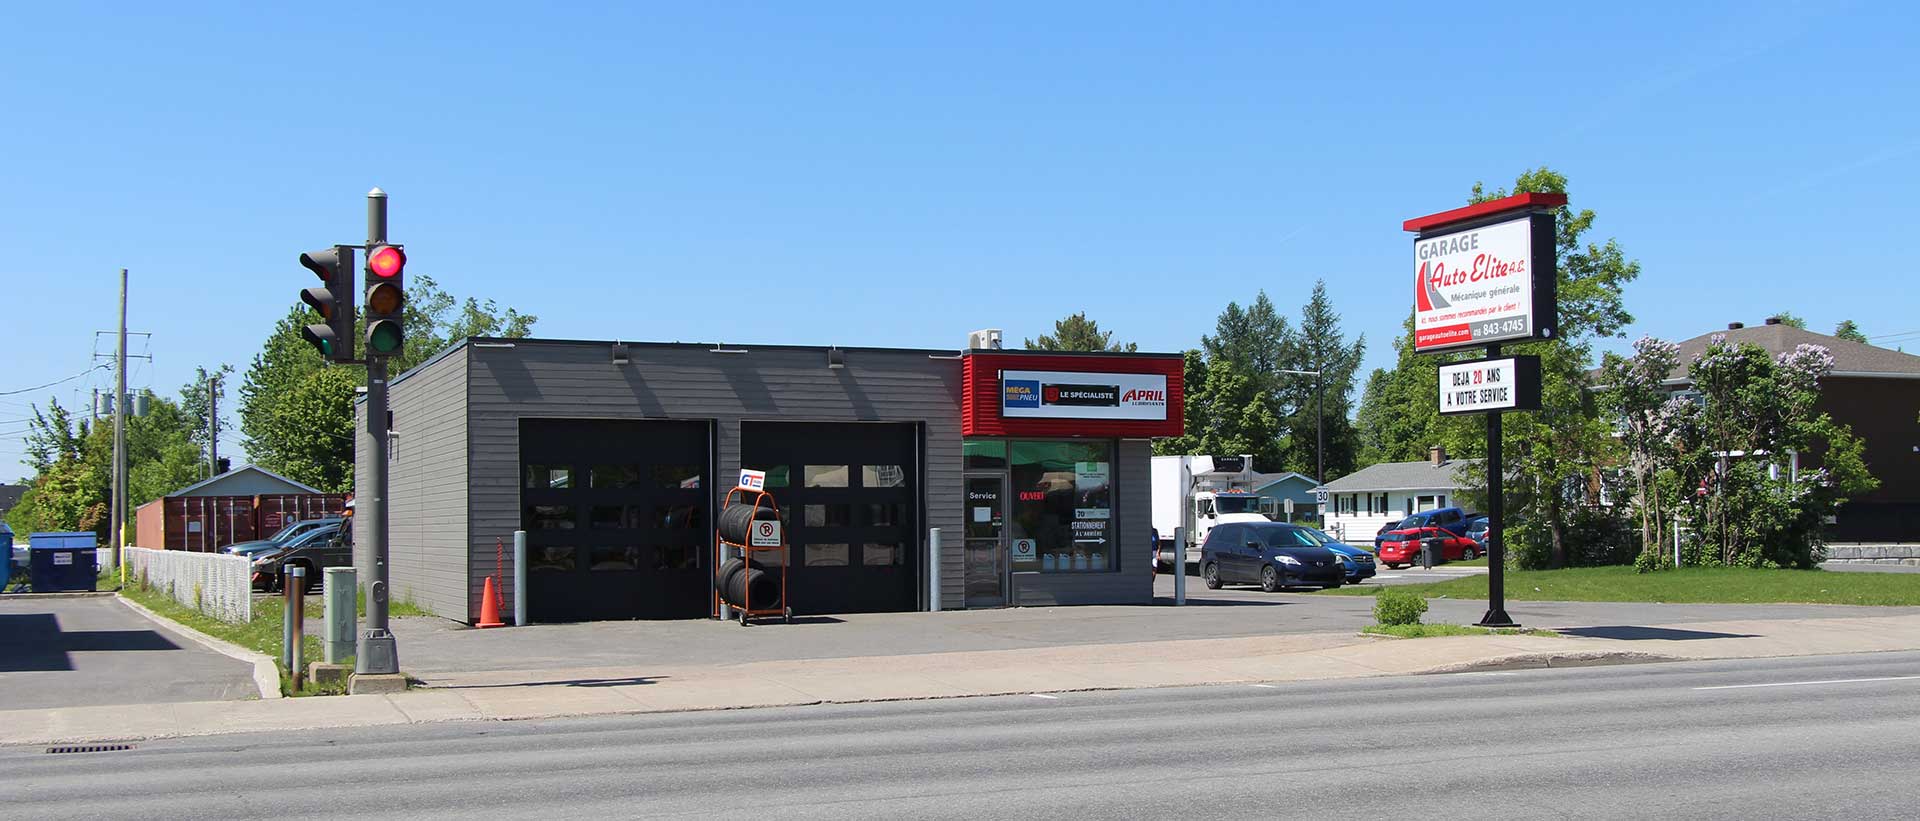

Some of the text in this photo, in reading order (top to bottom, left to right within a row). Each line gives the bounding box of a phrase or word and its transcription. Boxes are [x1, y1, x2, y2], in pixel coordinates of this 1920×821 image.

[1419, 233, 1479, 260] GARAGE
[1430, 262, 1467, 292] Auto
[1470, 253, 1508, 282] Elite
[1451, 284, 1520, 302] Mécanique générale
[1483, 319, 1524, 336] 843-4745
[1418, 329, 1469, 343] garageautoelite.com
[1453, 367, 1501, 386] DEJA 20 ANS
[1070, 390, 1114, 399] SPÉCIALISTE
[1122, 389, 1165, 402] APRIL
[1447, 387, 1508, 406] A VOTRE SERVICE
[969, 492, 997, 500] Service
[1019, 491, 1044, 501] OUVERT
[1318, 491, 1328, 501] 30
[1071, 521, 1106, 530] STATIONNEMENT
